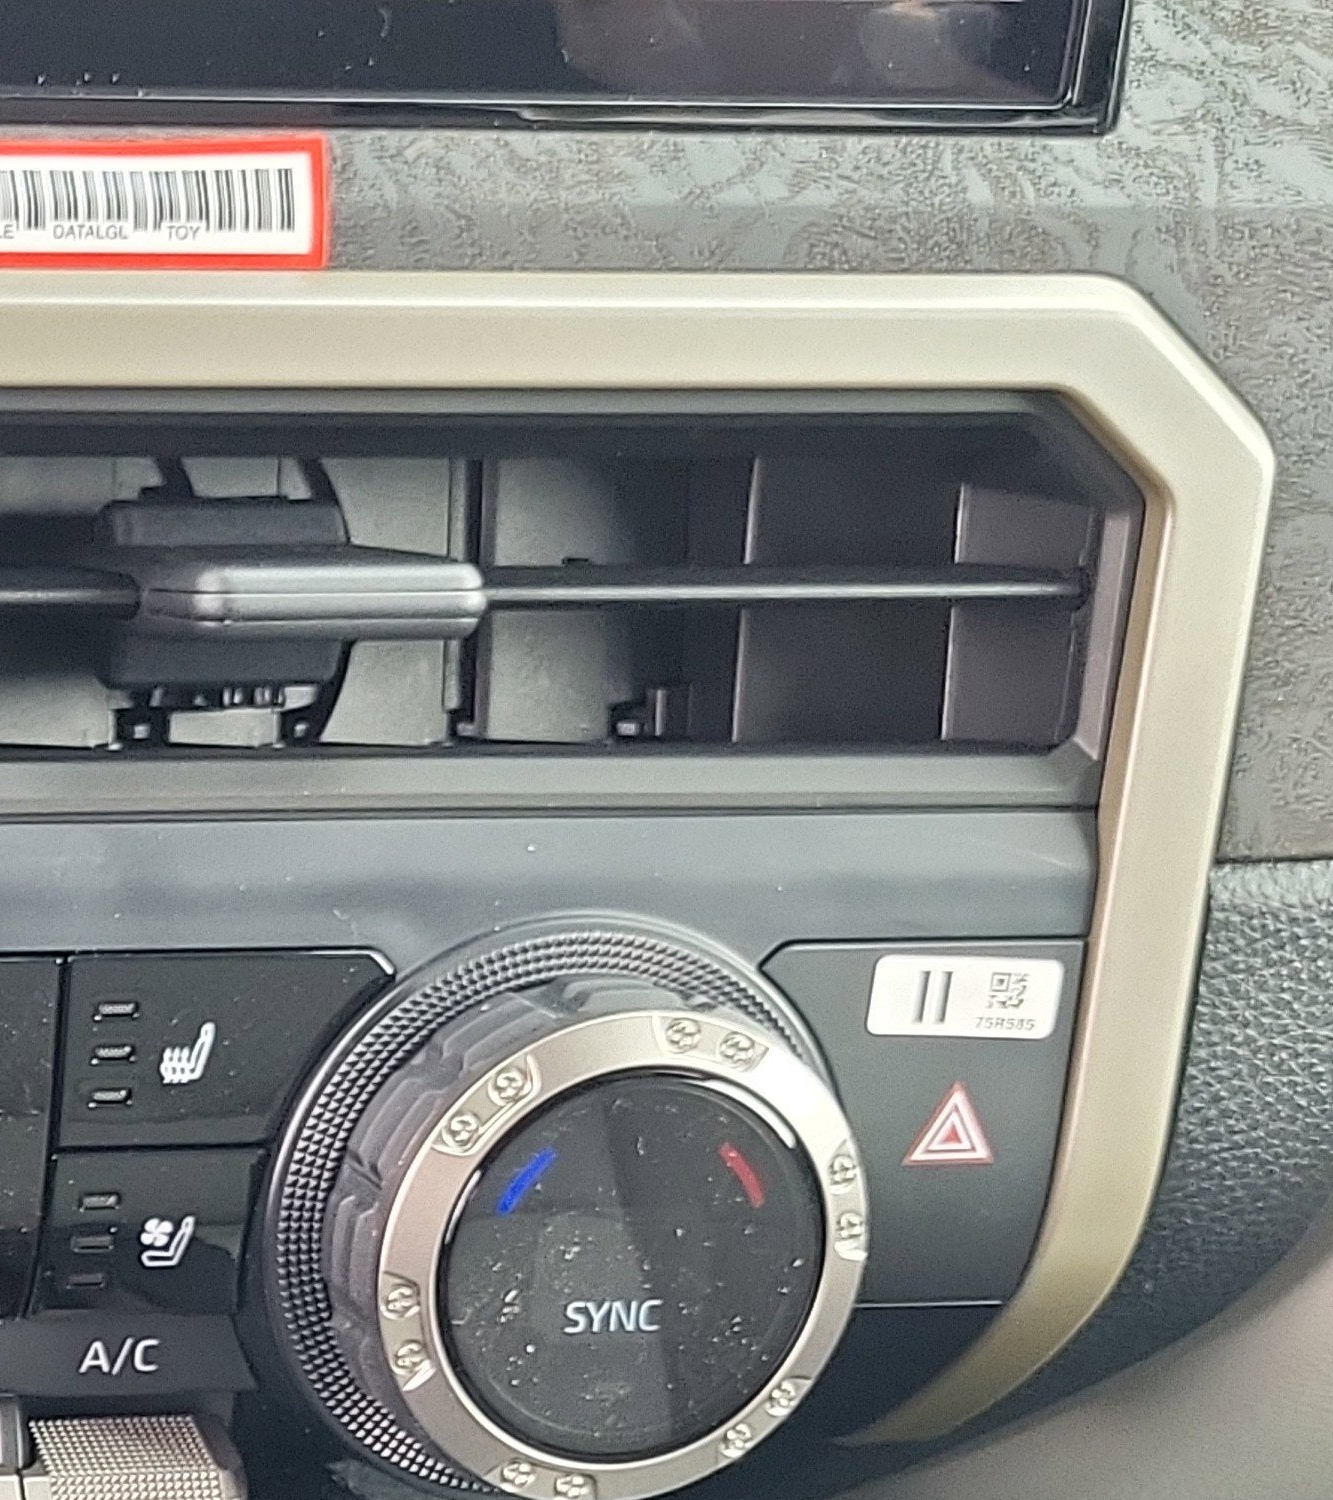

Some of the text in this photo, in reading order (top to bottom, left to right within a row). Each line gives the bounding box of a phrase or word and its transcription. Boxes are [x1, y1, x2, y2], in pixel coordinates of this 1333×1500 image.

[167, 225, 201, 240] TOY
[563, 1299, 662, 1335] SYNC
[80, 1338, 162, 1373] A/C
